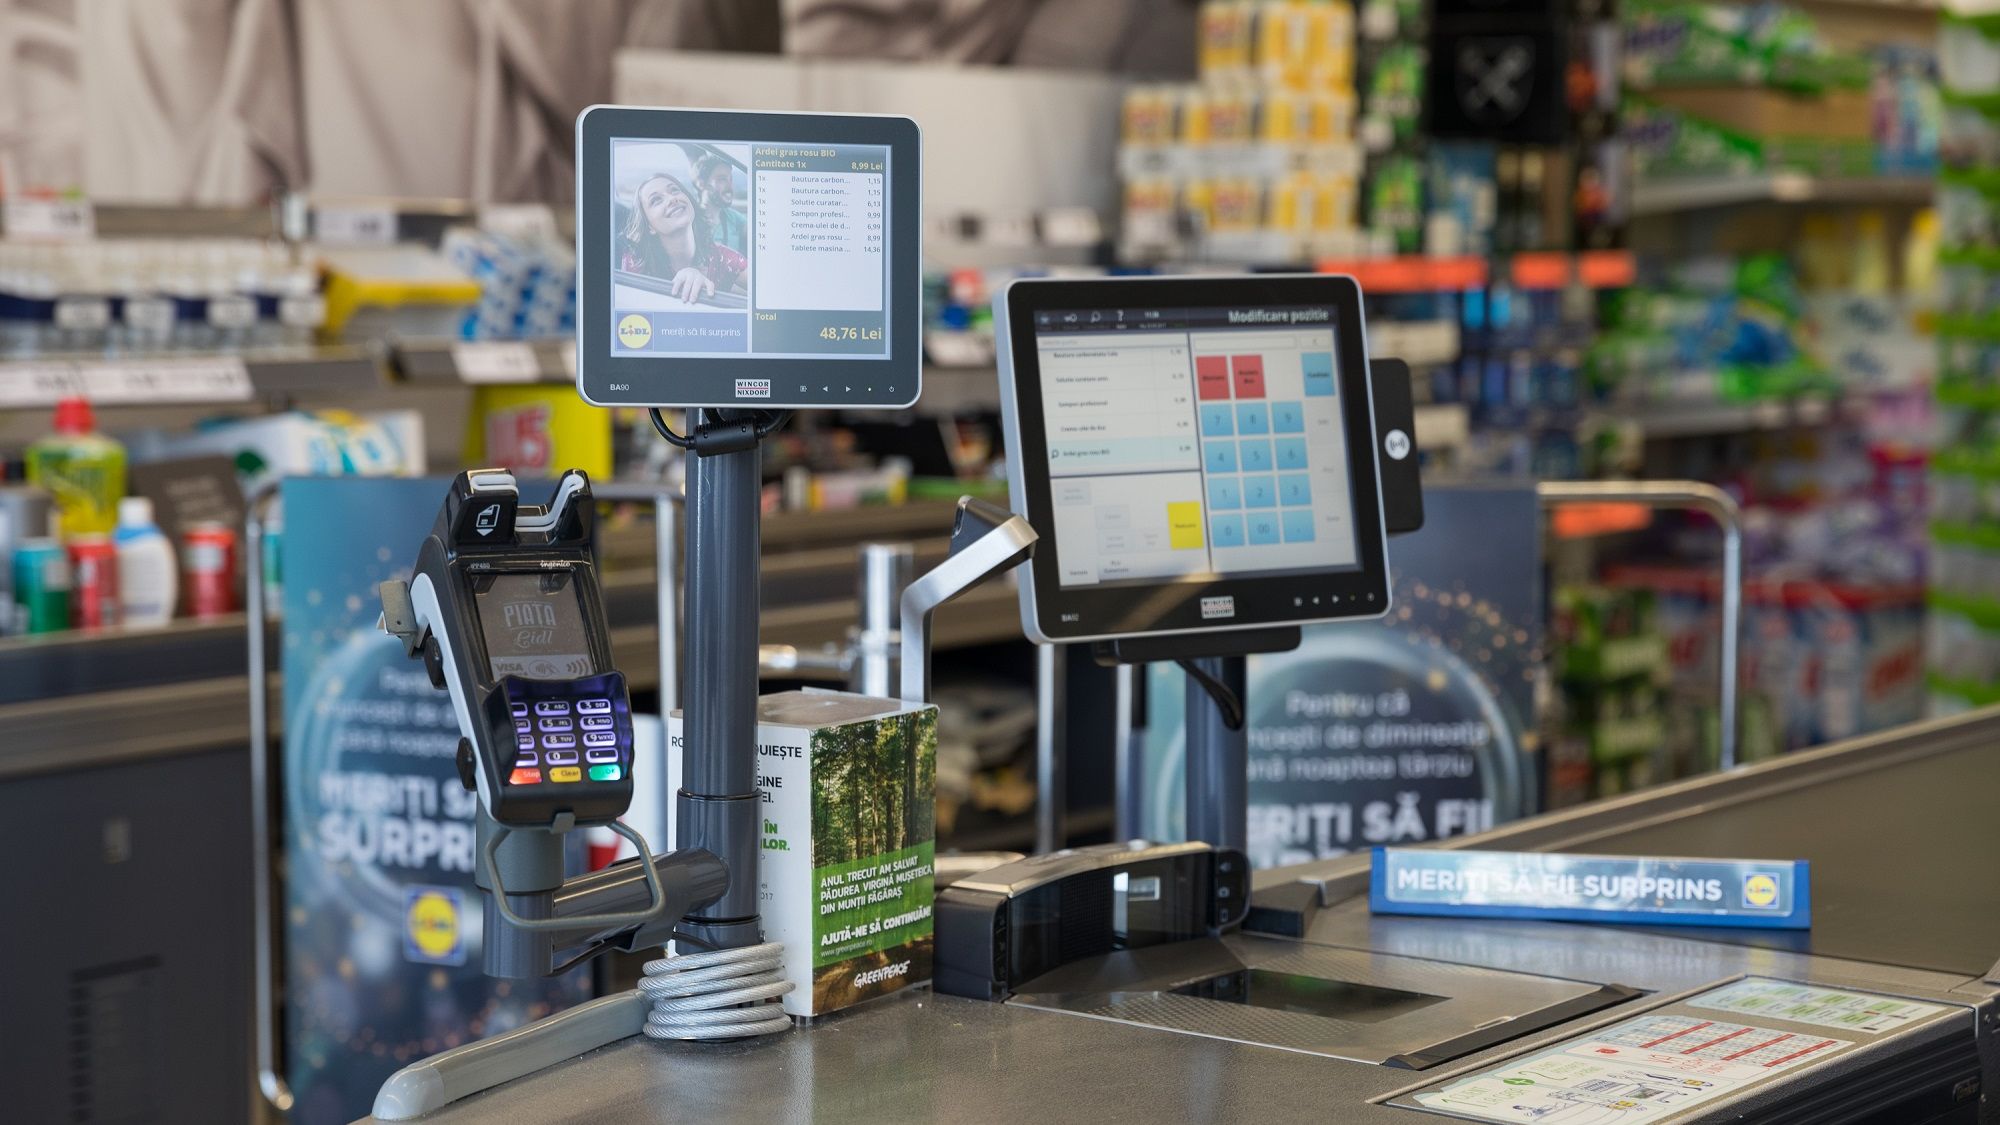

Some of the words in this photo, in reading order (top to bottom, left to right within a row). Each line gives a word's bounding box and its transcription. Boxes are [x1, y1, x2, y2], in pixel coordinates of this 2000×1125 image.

[755, 147, 778, 156] Ardei
[780, 149, 798, 158] gras
[820, 149, 836, 157] BIO
[755, 159, 795, 168] Cantitate
[797, 160, 807, 169] 1x
[851, 162, 869, 171] 8,99
[871, 162, 883, 170] Lei
[791, 187, 819, 195] Bautura
[791, 210, 819, 219] Sampon
[810, 234, 826, 242] gras
[791, 244, 817, 252] Tablete
[755, 312, 777, 321] Total
[1228, 309, 1289, 324] Modificare
[1290, 308, 1329, 324] pozitie
[820, 327, 857, 341] 48,76
[861, 327, 882, 340] Lei
[610, 383, 630, 391] BA90
[540, 560, 571, 568] ingenico
[495, 663, 524, 672] VISA
[543, 703, 550, 711] 2
[586, 700, 592, 709] 3
[547, 720, 553, 728] 5
[588, 717, 595, 726] 6
[590, 734, 597, 742] 9
[1324, 724, 1360, 749] de
[553, 752, 560, 760] 0
[759, 744, 802, 760] UIEȘTE
[762, 791, 774, 803] EI.
[1246, 801, 1352, 851] ERIȚI
[1362, 789, 1428, 842] SĂ
[764, 818, 778, 834] ÎN
[319, 812, 477, 872] SURPR
[821, 874, 845, 889] ANUL
[847, 866, 878, 882] TRECUT
[879, 863, 892, 876] AM
[893, 855, 919, 872] SALVAT
[821, 883, 860, 902] PĂDUREA
[863, 873, 895, 892] VIRGINĂ
[1583, 875, 1723, 902] SURPRINS
[821, 902, 836, 915] DIN
[838, 895, 866, 911] MUNȚII
[821, 924, 868, 947] AJUTĂ-NE
[869, 917, 882, 935] SĂ
[883, 904, 932, 931] CONTINUĂM!
[821, 939, 873, 958] www.greenpeace.ro
[853, 959, 911, 988] GREENPEACE
